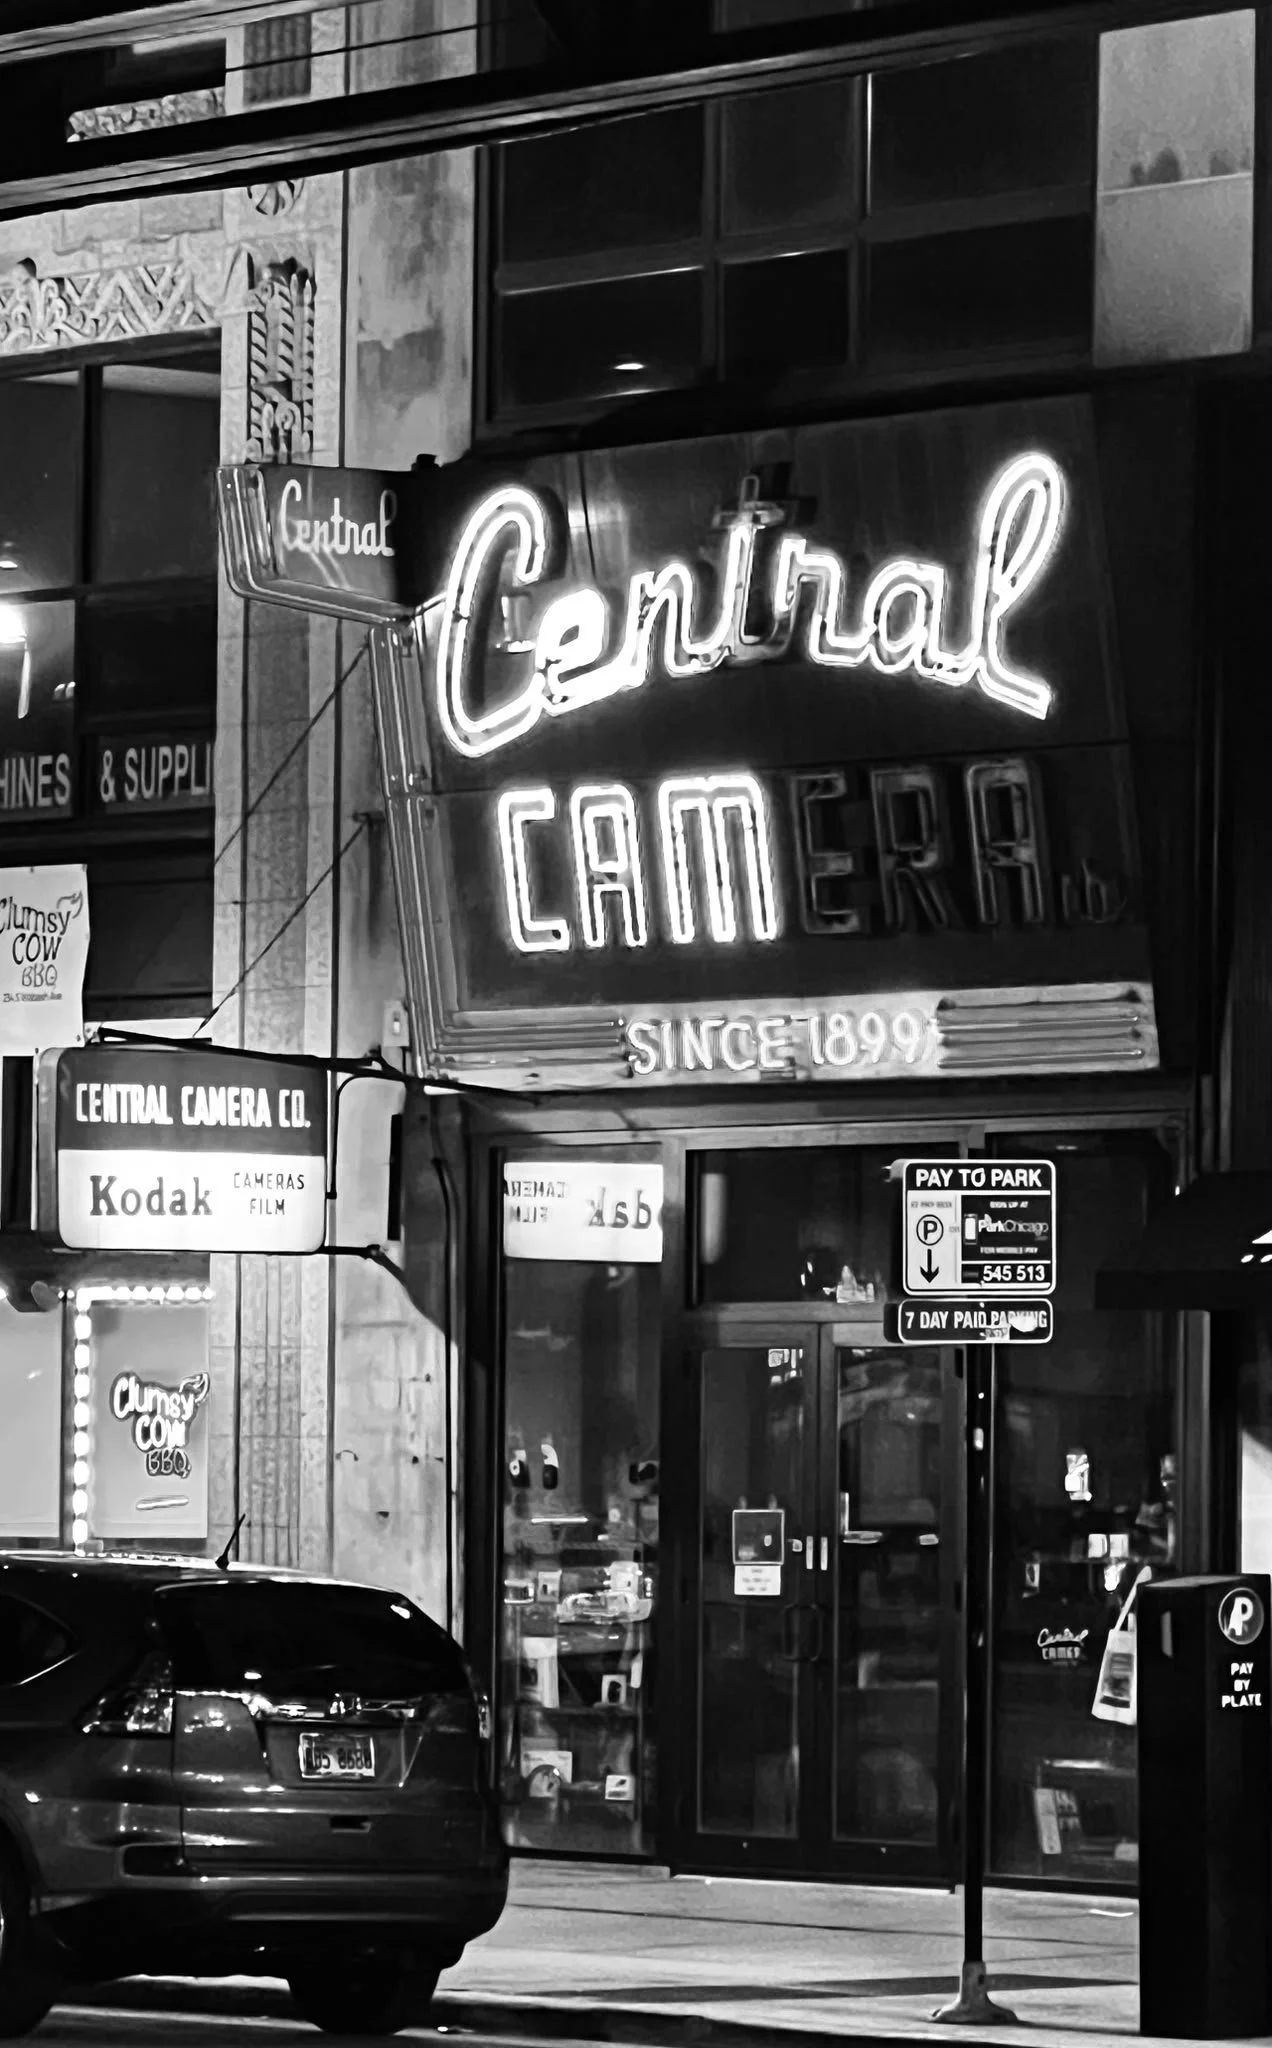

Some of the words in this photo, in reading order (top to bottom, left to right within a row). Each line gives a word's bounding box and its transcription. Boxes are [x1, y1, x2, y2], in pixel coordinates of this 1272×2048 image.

[280, 479, 397, 557] Central
[437, 452, 1067, 758] Central
[101, 750, 116, 803] &
[498, 757, 1046, 953] CAMERA
[12, 933, 62, 965] COW
[22, 963, 58, 989] BBQ
[626, 1017, 786, 1075] SINCE
[809, 1011, 922, 1066] 1899
[76, 1083, 173, 1125] CENTRAL
[181, 1086, 272, 1128] CAMERA
[278, 1089, 311, 1128] CO.
[233, 1172, 305, 1190] CAMERAS
[916, 1169, 953, 1187] PAY
[958, 1168, 986, 1187] TO
[991, 1169, 1042, 1187] PARK
[89, 1175, 213, 1217] Kodak
[249, 1198, 285, 1216] FILM
[982, 1265, 1012, 1282] 545
[1017, 1265, 1045, 1282] 513
[905, 1312, 914, 1328] 7
[920, 1312, 948, 1329] DAY
[954, 1311, 987, 1328] PAID
[113, 1375, 195, 1421] Clumsy
[135, 1414, 185, 1451] COW
[148, 1448, 191, 1478] BBQ
[1230, 1662, 1254, 1676] PAY
[1222, 1693, 1262, 1707] PLATE
[1234, 1679, 1250, 1692] BY
